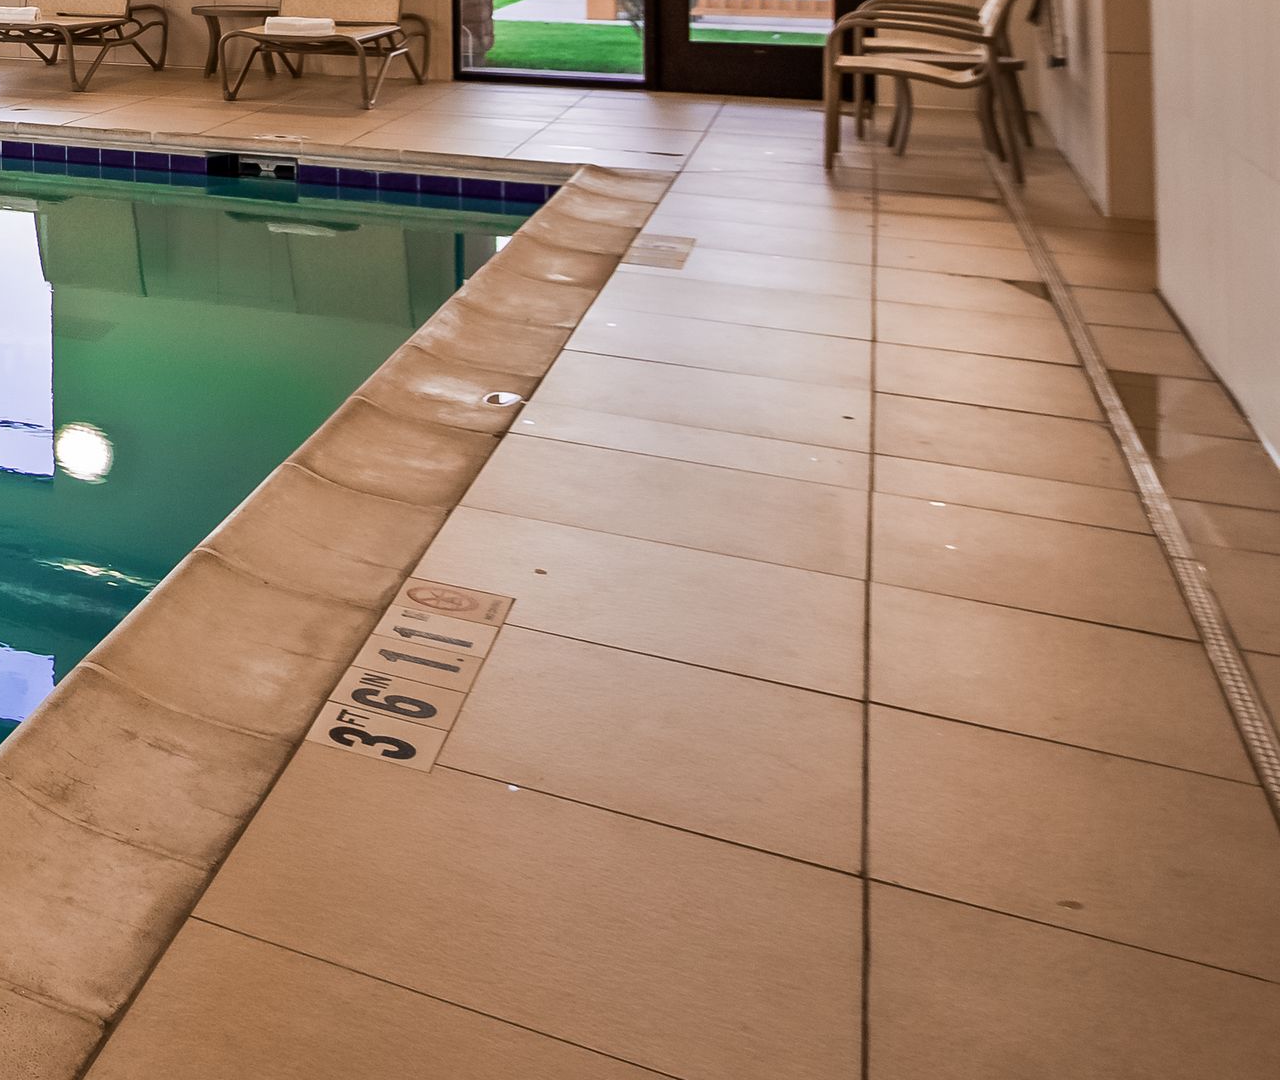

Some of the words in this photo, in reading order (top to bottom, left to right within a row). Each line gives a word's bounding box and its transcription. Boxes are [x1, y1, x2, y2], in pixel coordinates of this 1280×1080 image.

[359, 673, 393, 690] IN
[351, 687, 438, 719] 6
[336, 709, 370, 728] FT
[328, 725, 417, 760] 3
